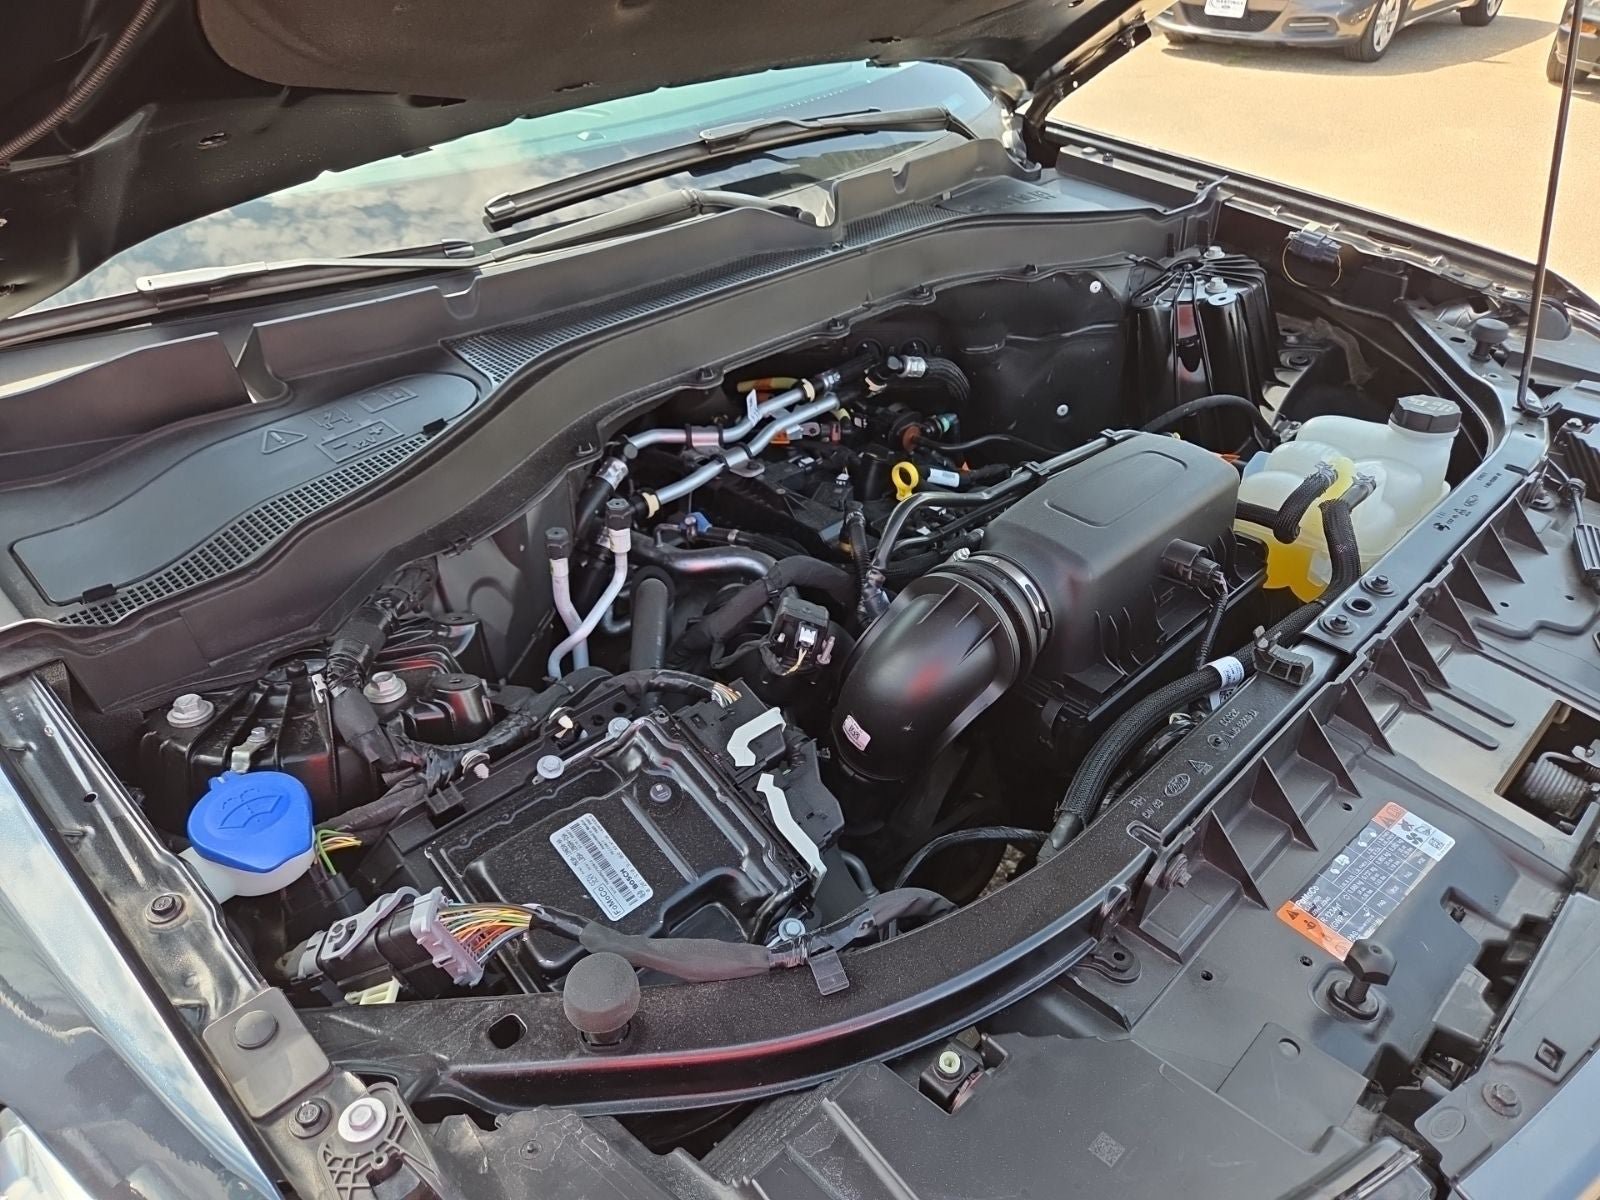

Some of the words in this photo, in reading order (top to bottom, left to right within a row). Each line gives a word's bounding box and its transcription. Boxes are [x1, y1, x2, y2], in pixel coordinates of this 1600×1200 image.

[353, 437, 376, 450] 12V
[619, 868, 638, 889] BOSCH
[598, 886, 621, 914] FoMoCo
[1294, 885, 1320, 907] FoMoCo
